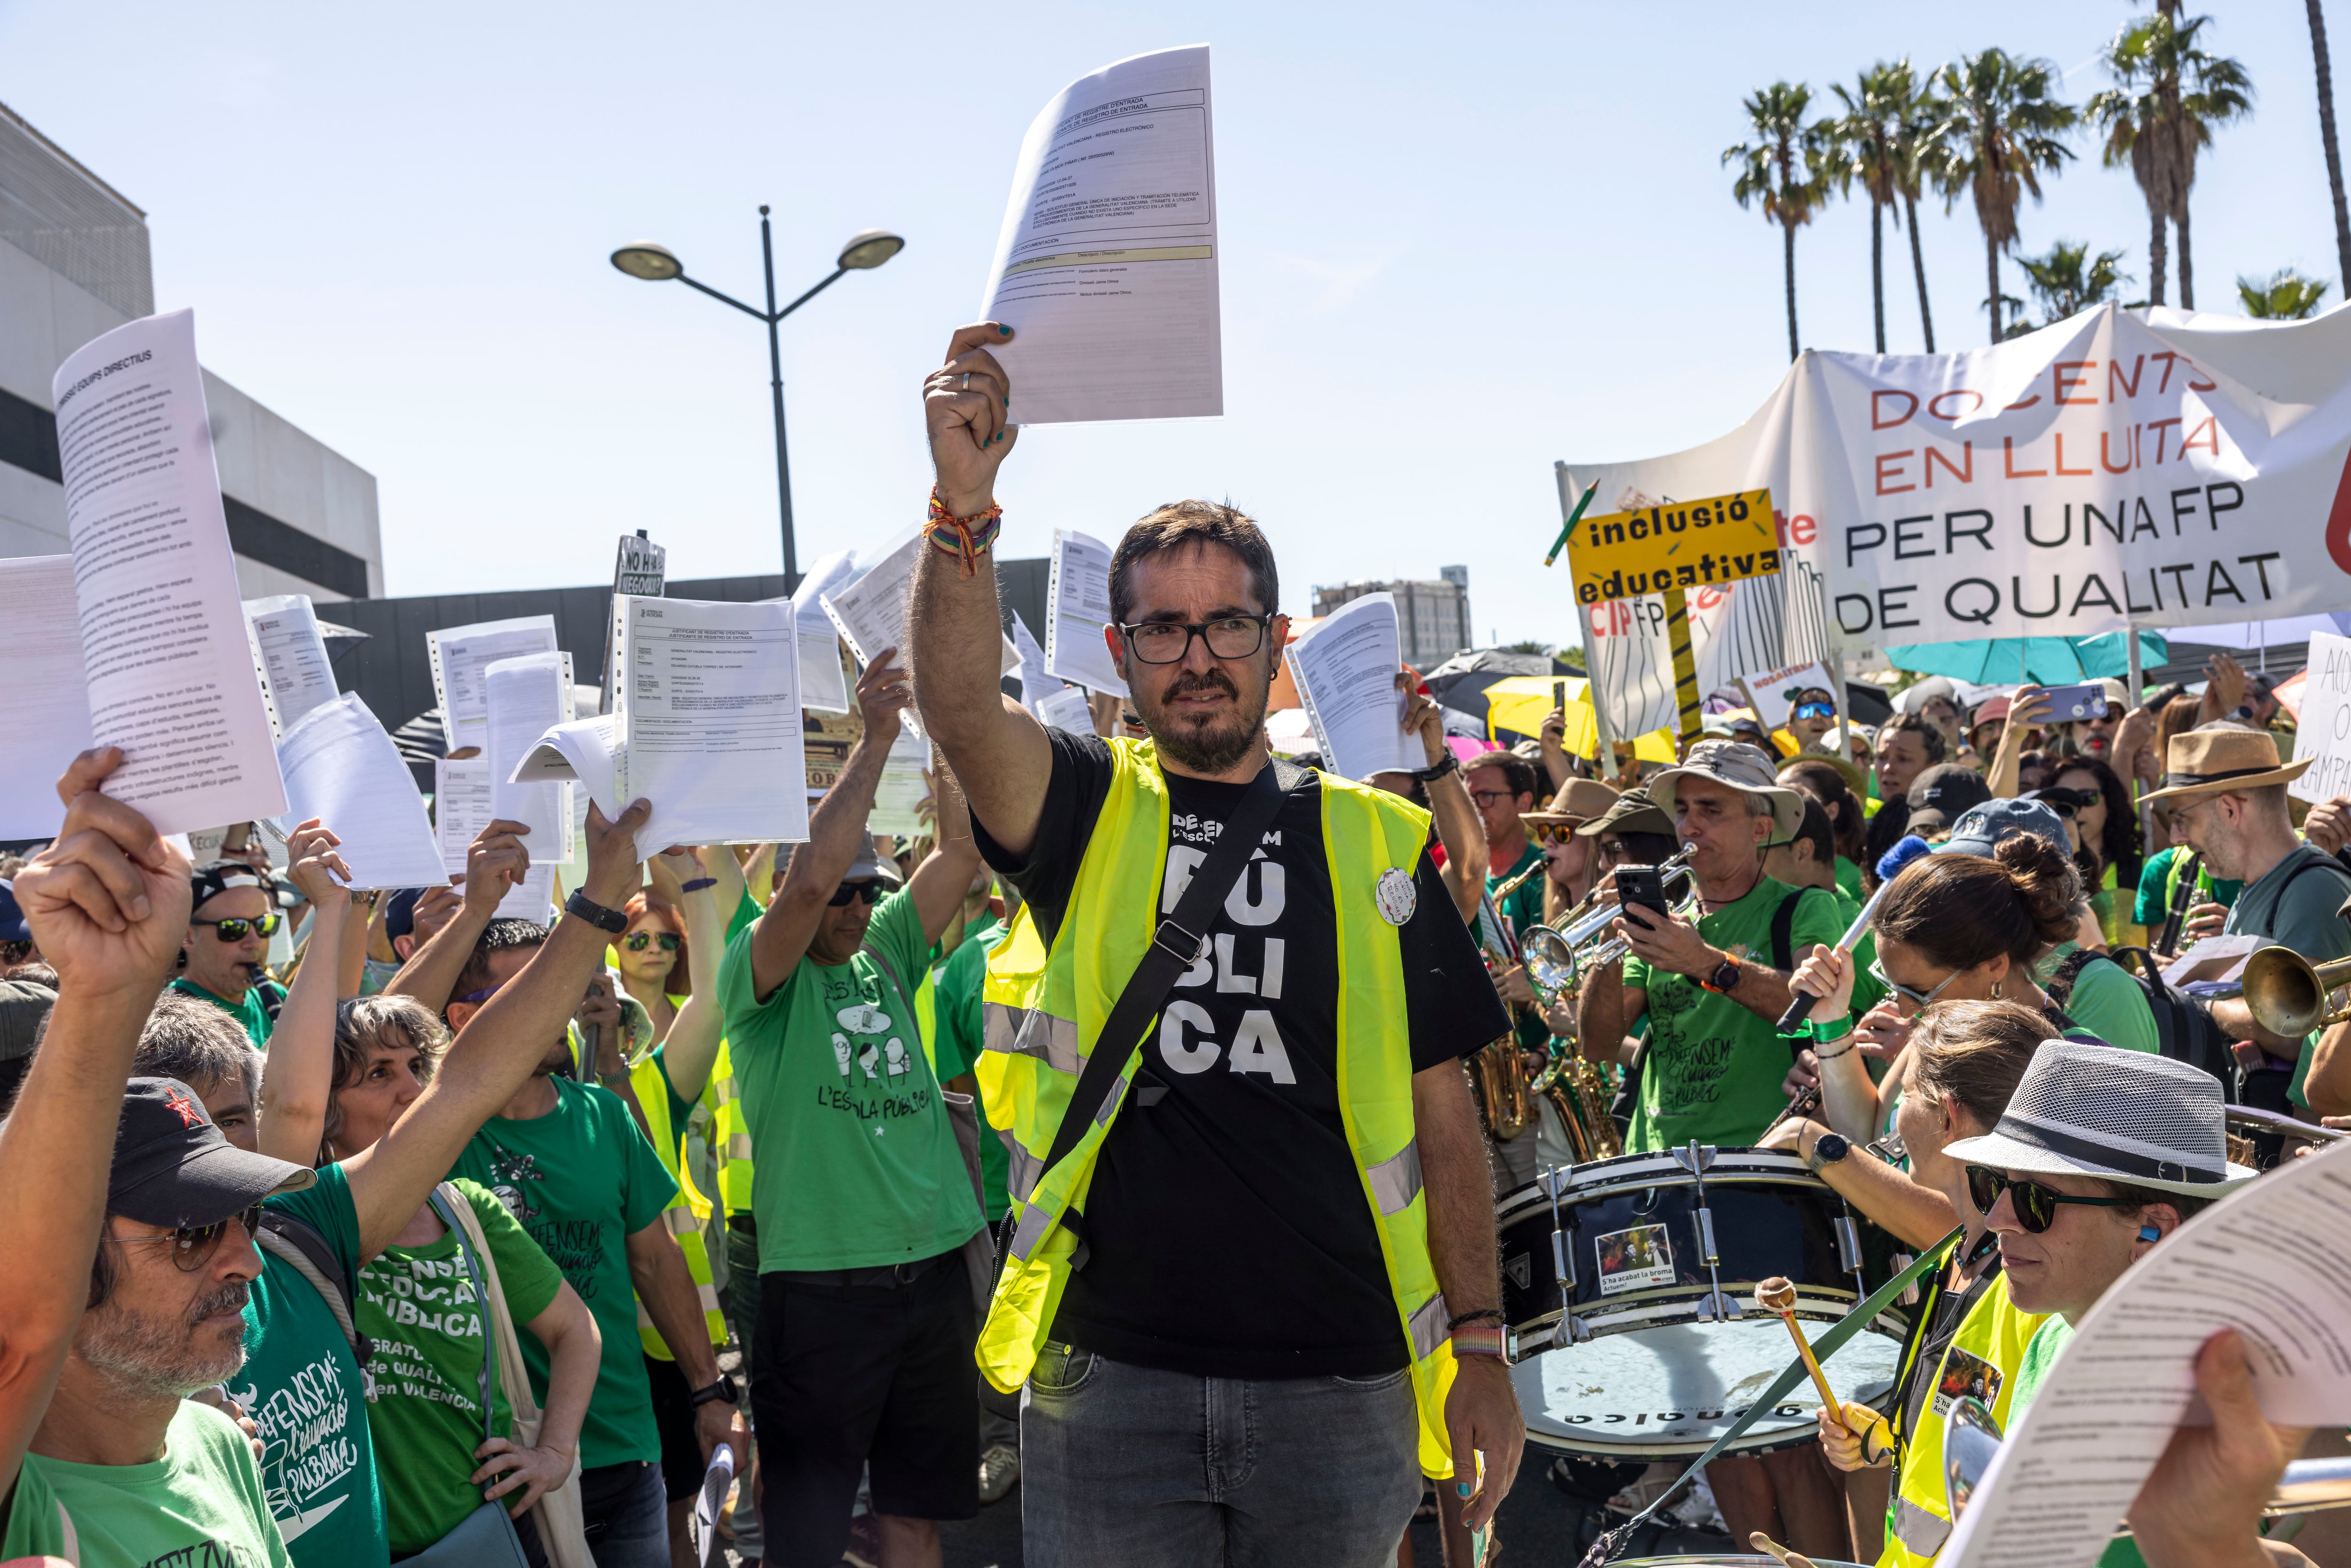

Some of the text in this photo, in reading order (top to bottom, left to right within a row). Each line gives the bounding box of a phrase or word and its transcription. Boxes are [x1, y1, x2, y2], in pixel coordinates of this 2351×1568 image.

[1082, 110, 1109, 124] REGISTRO
[1120, 103, 1148, 112] ENTRADA
[1083, 104, 1109, 117] REGISTRE
[1111, 97, 1144, 108] D'ENTRADA
[1066, 124, 1153, 146] VALENCIANA REGISTRO ELECTRÓNICO
[1050, 163, 1064, 172] OLMOS
[1035, 199, 1048, 208] GVRTE
[1047, 204, 1068, 212] SOLICITUD
[1033, 213, 1068, 225] EXCLUSIVAMENTE
[1039, 207, 1075, 219] PROCEDIMIENTOS
[1021, 238, 1059, 250] DOCUMENTACIÓN
[1875, 416, 2219, 496] EN LLUITA
[1590, 492, 1749, 547] inclusió
[1846, 480, 2244, 567] PER UNA FP
[1579, 550, 1780, 604] educativa
[1835, 552, 2280, 635] DE QUALITAT
[1394, 883, 1399, 892] NO
[1160, 1000, 1297, 1085] CA
[1602, 1276, 1617, 1285] S'ha
[1618, 1272, 1640, 1284] acabat
[1650, 1268, 1673, 1276] broma
[1604, 1282, 1627, 1292] Actuem!
[254, 1357, 339, 1439] DEFENSEM
[1935, 1395, 1950, 1409] S'ha
[1933, 1404, 1947, 1416] Actu
